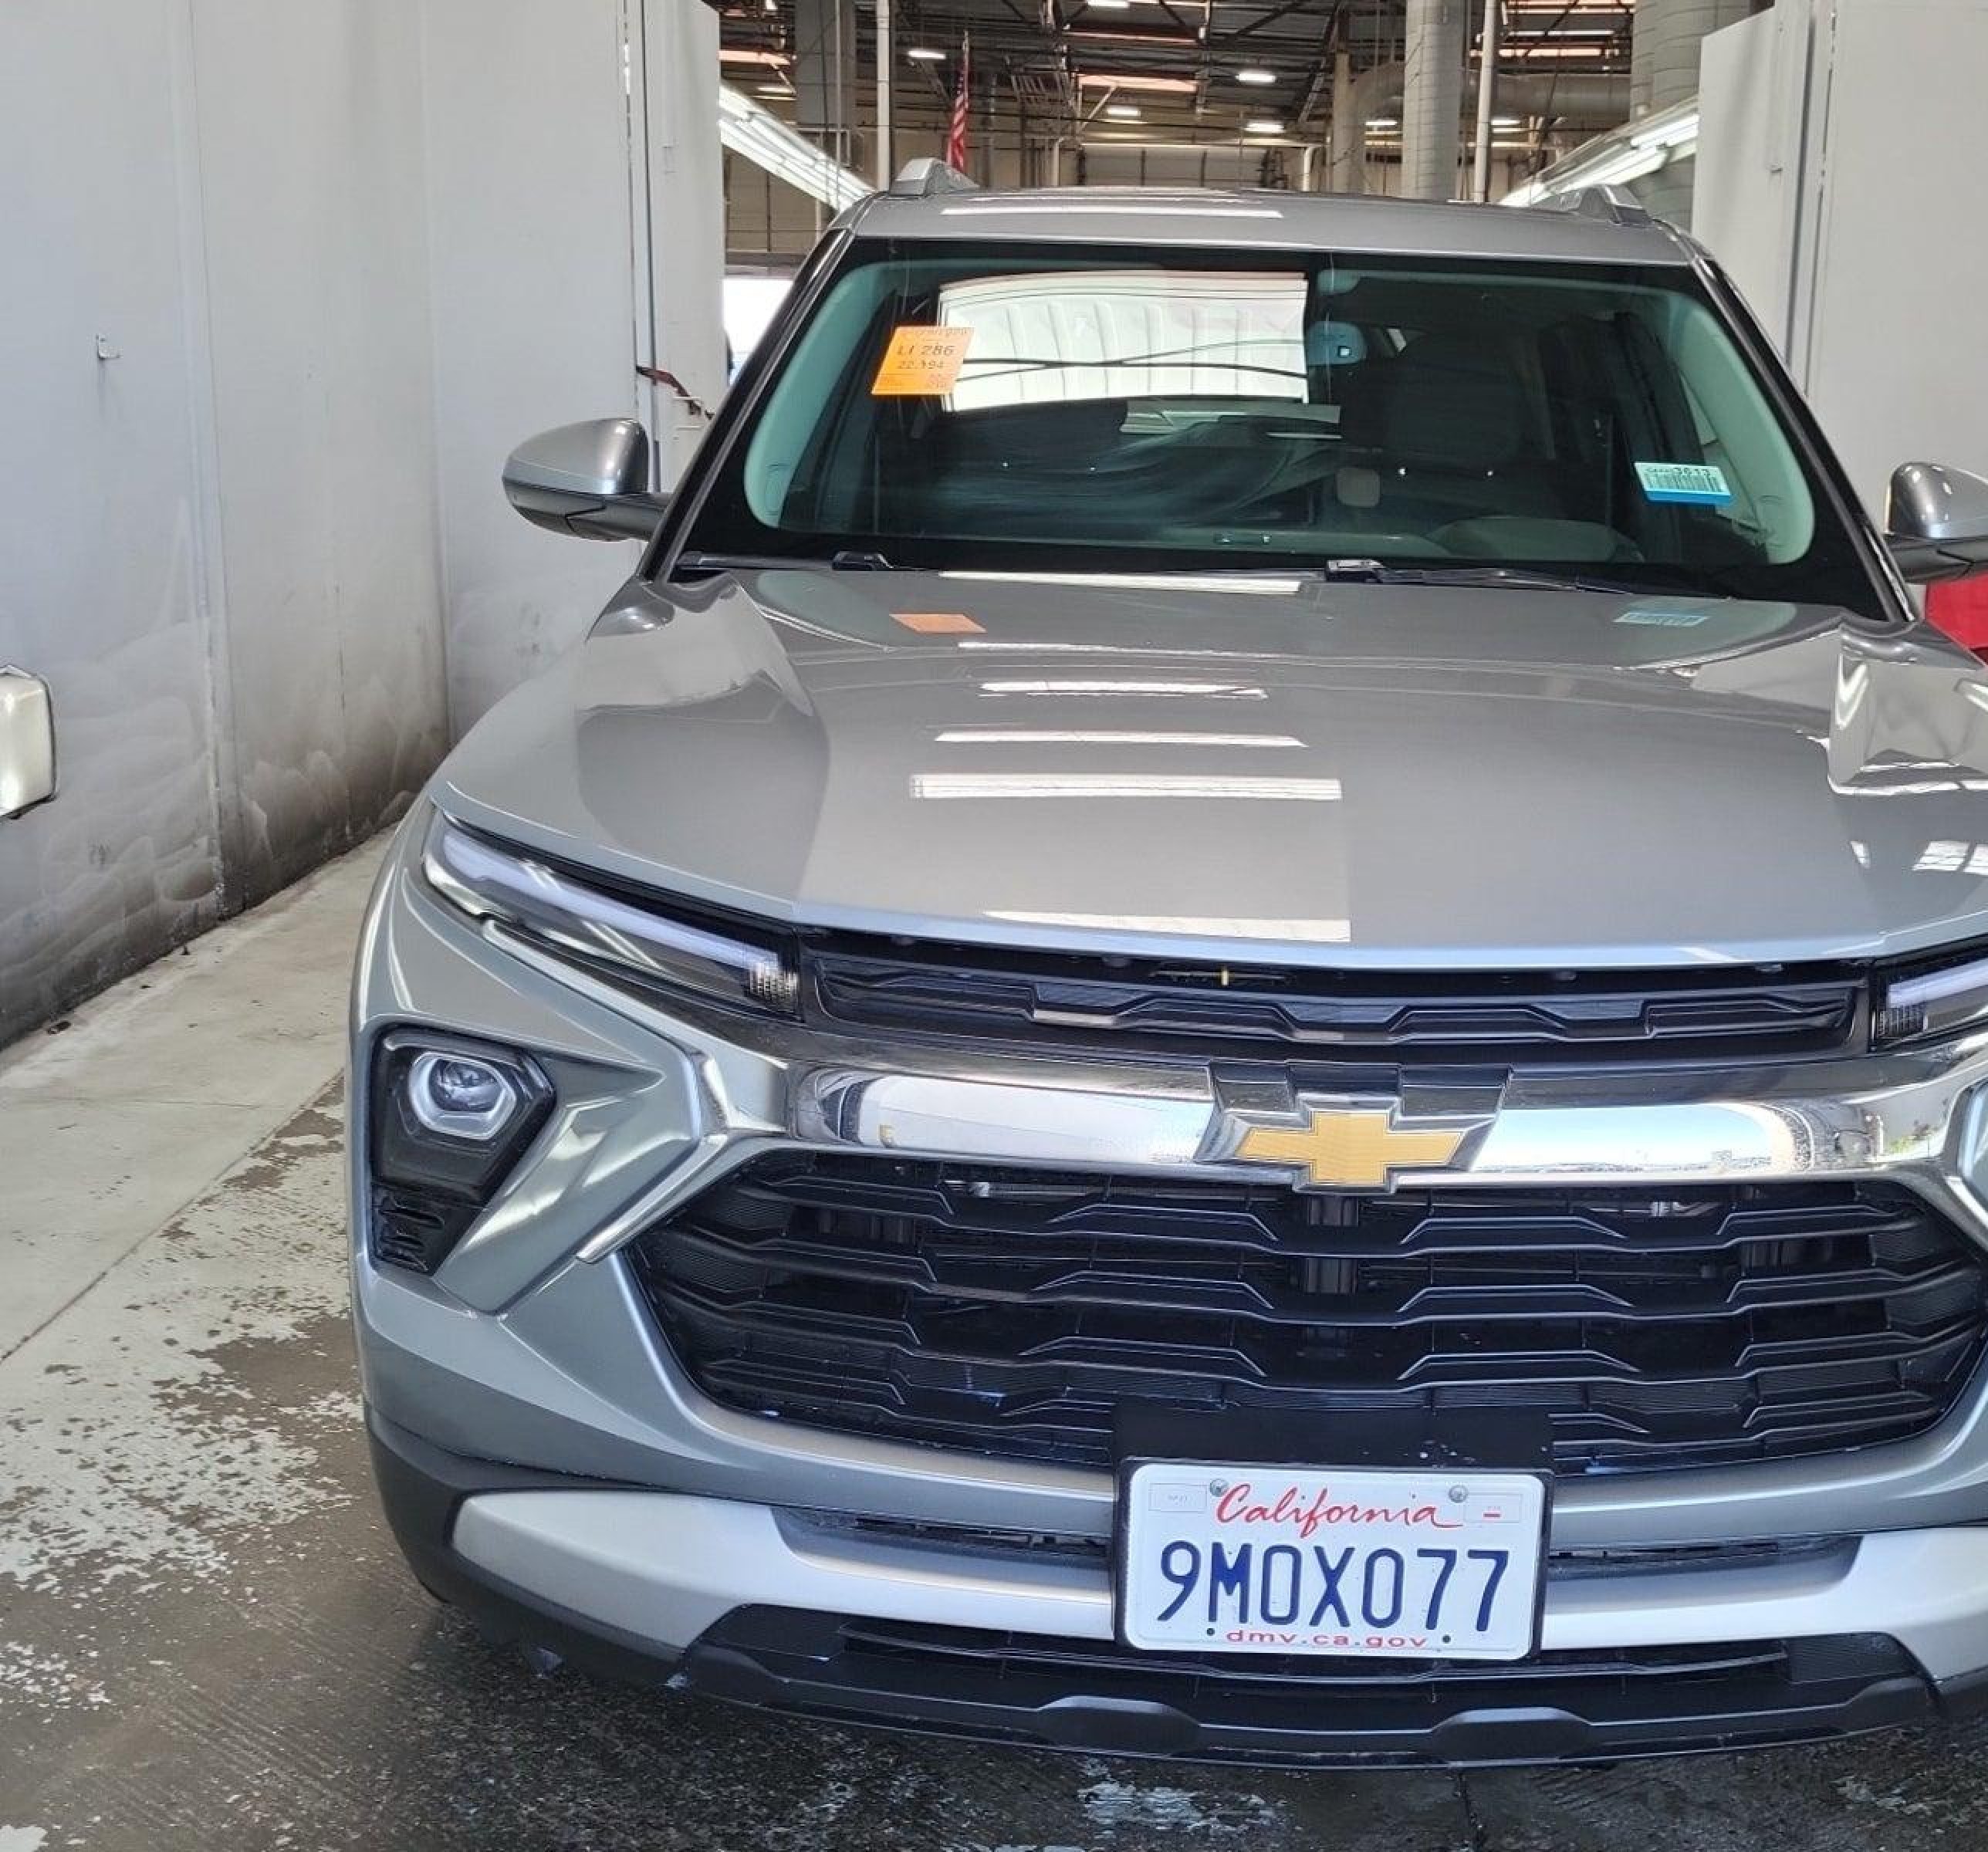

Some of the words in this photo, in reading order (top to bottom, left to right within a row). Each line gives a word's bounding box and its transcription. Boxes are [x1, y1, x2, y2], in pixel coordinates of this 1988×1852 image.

[1215, 1483, 1463, 1539] California
[1157, 1539, 1510, 1632] 9MOX077
[1226, 1628, 1428, 1649] dmv.ca.gov
